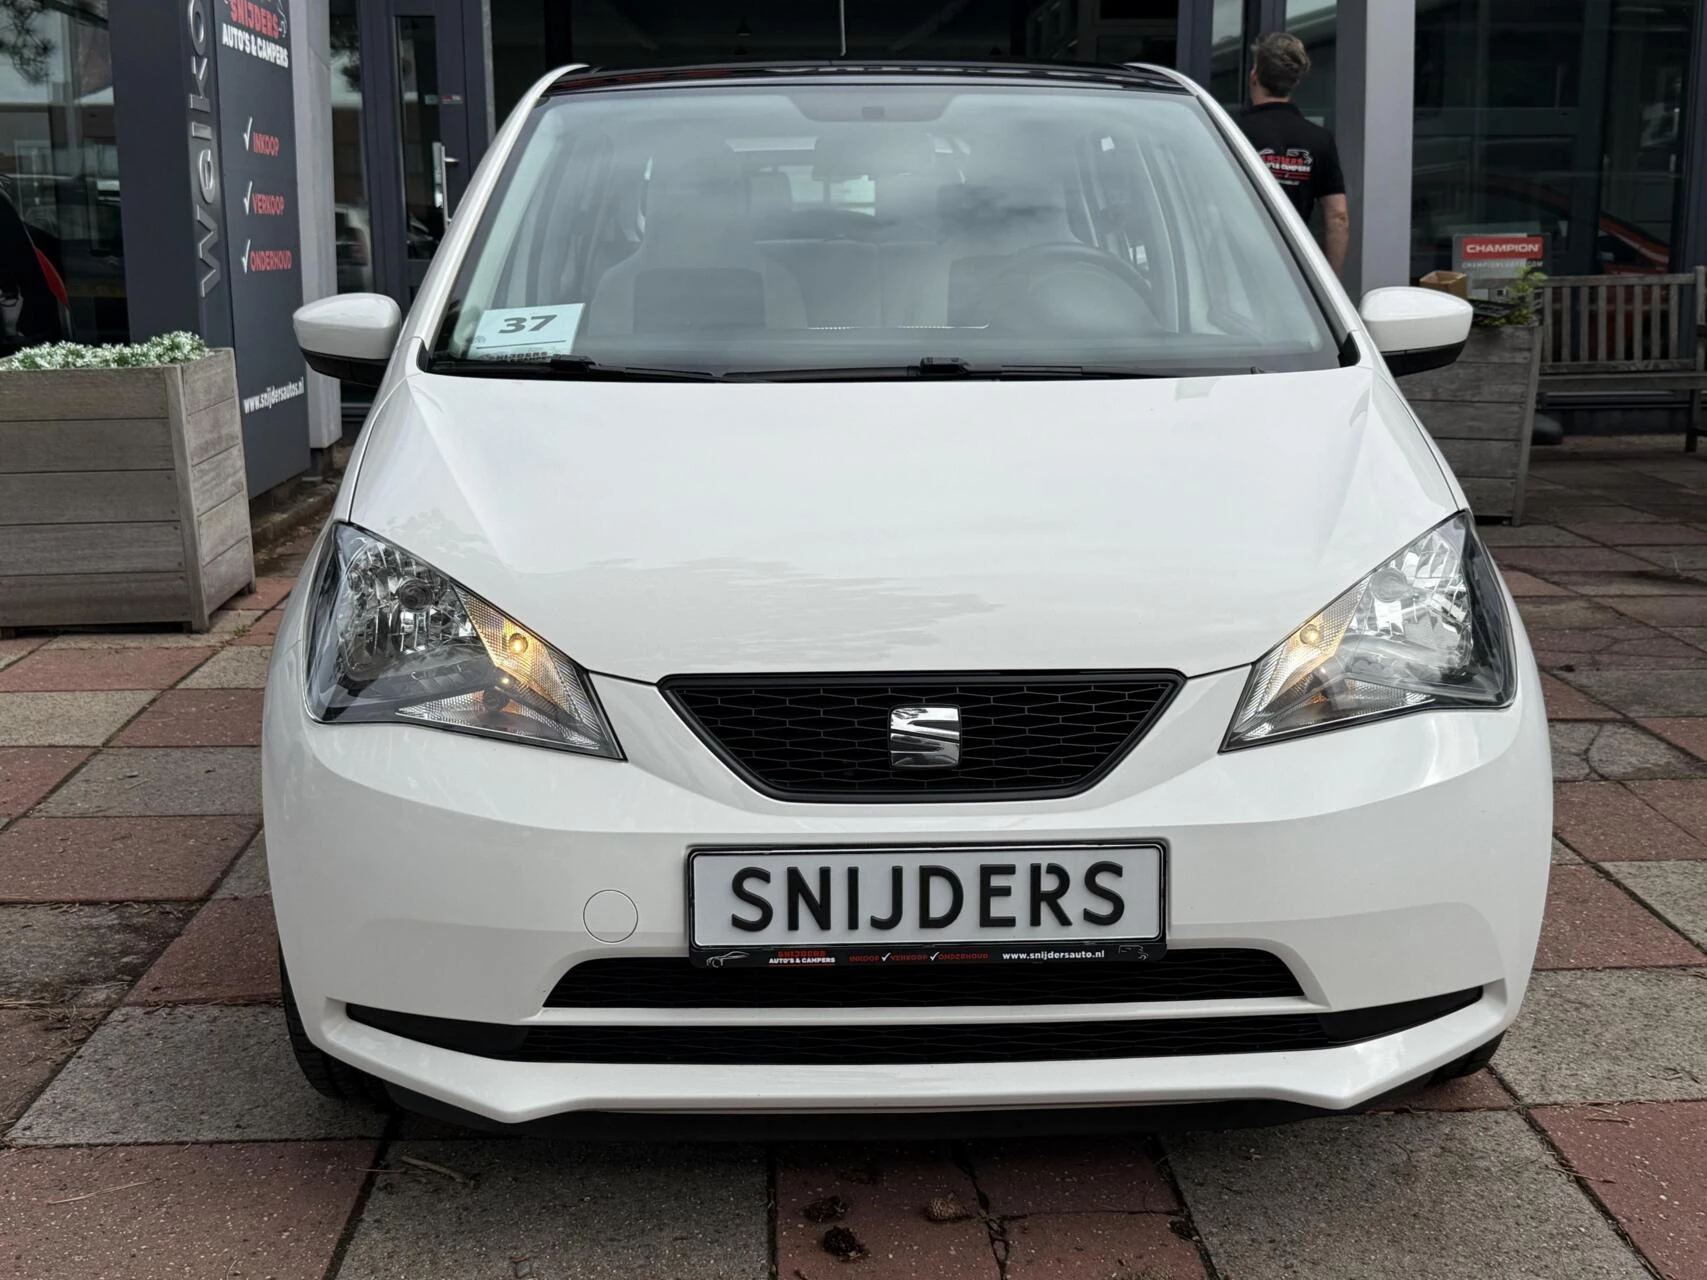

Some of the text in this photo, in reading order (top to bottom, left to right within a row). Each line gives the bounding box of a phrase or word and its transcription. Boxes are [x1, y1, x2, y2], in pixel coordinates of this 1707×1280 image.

[222, 23, 251, 54] AUTO'S
[256, 37, 289, 68] CAMPERS
[253, 132, 279, 156] INKOOP
[252, 193, 285, 217] VERKOOP
[1466, 243, 1540, 253] CHAMPION
[250, 250, 292, 271] ONDERHOUD
[498, 314, 558, 334] 37
[731, 861, 1126, 932] SNIJDERS
[1002, 950, 1105, 960] www.snijdersauto.nl
